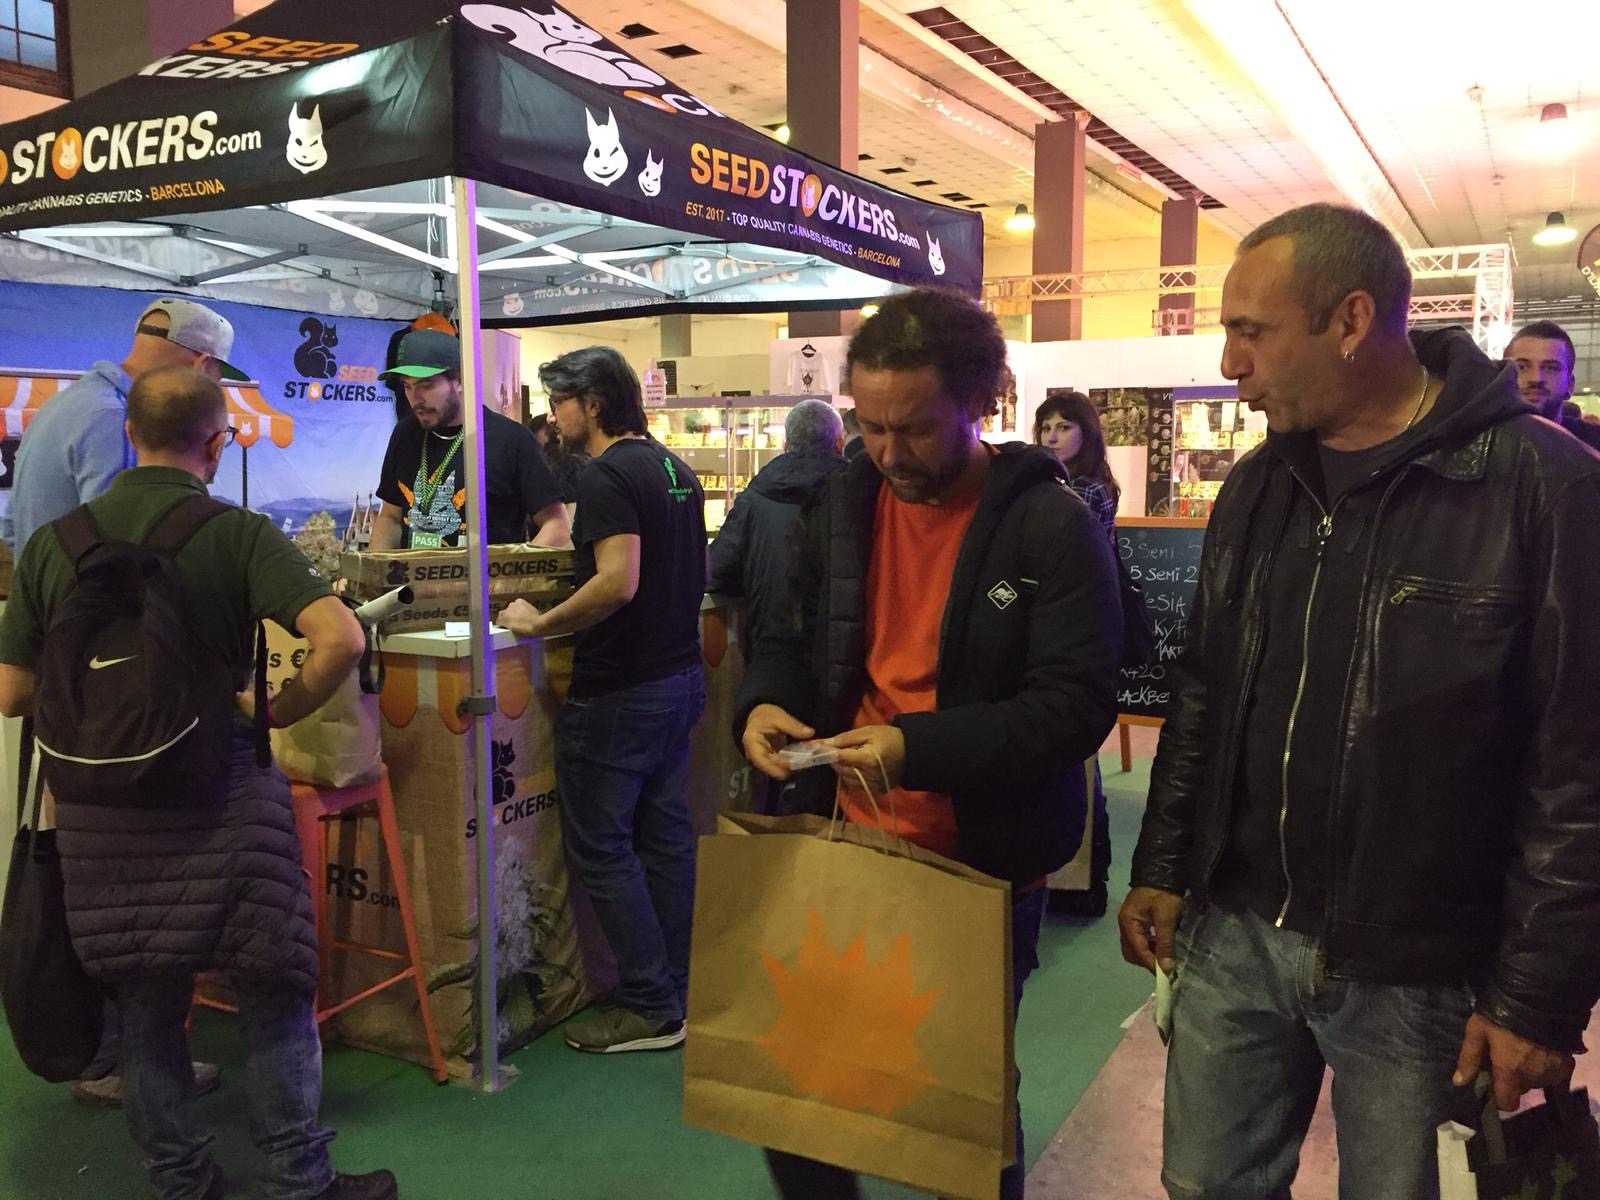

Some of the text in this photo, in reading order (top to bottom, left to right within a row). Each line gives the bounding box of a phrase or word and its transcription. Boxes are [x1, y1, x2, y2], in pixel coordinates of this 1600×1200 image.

[690, 142, 770, 199] SEED
[85, 188, 143, 205] GENETICS
[150, 178, 225, 201] BARCELONA
[686, 201, 901, 268] EST. 2017 TOP QUALITY CANNABIS GENETICS BARCELONA
[338, 364, 378, 383] SEED
[415, 535, 438, 547] PASS
[1130, 565, 1142, 580] 5
[403, 607, 449, 621] Seeds
